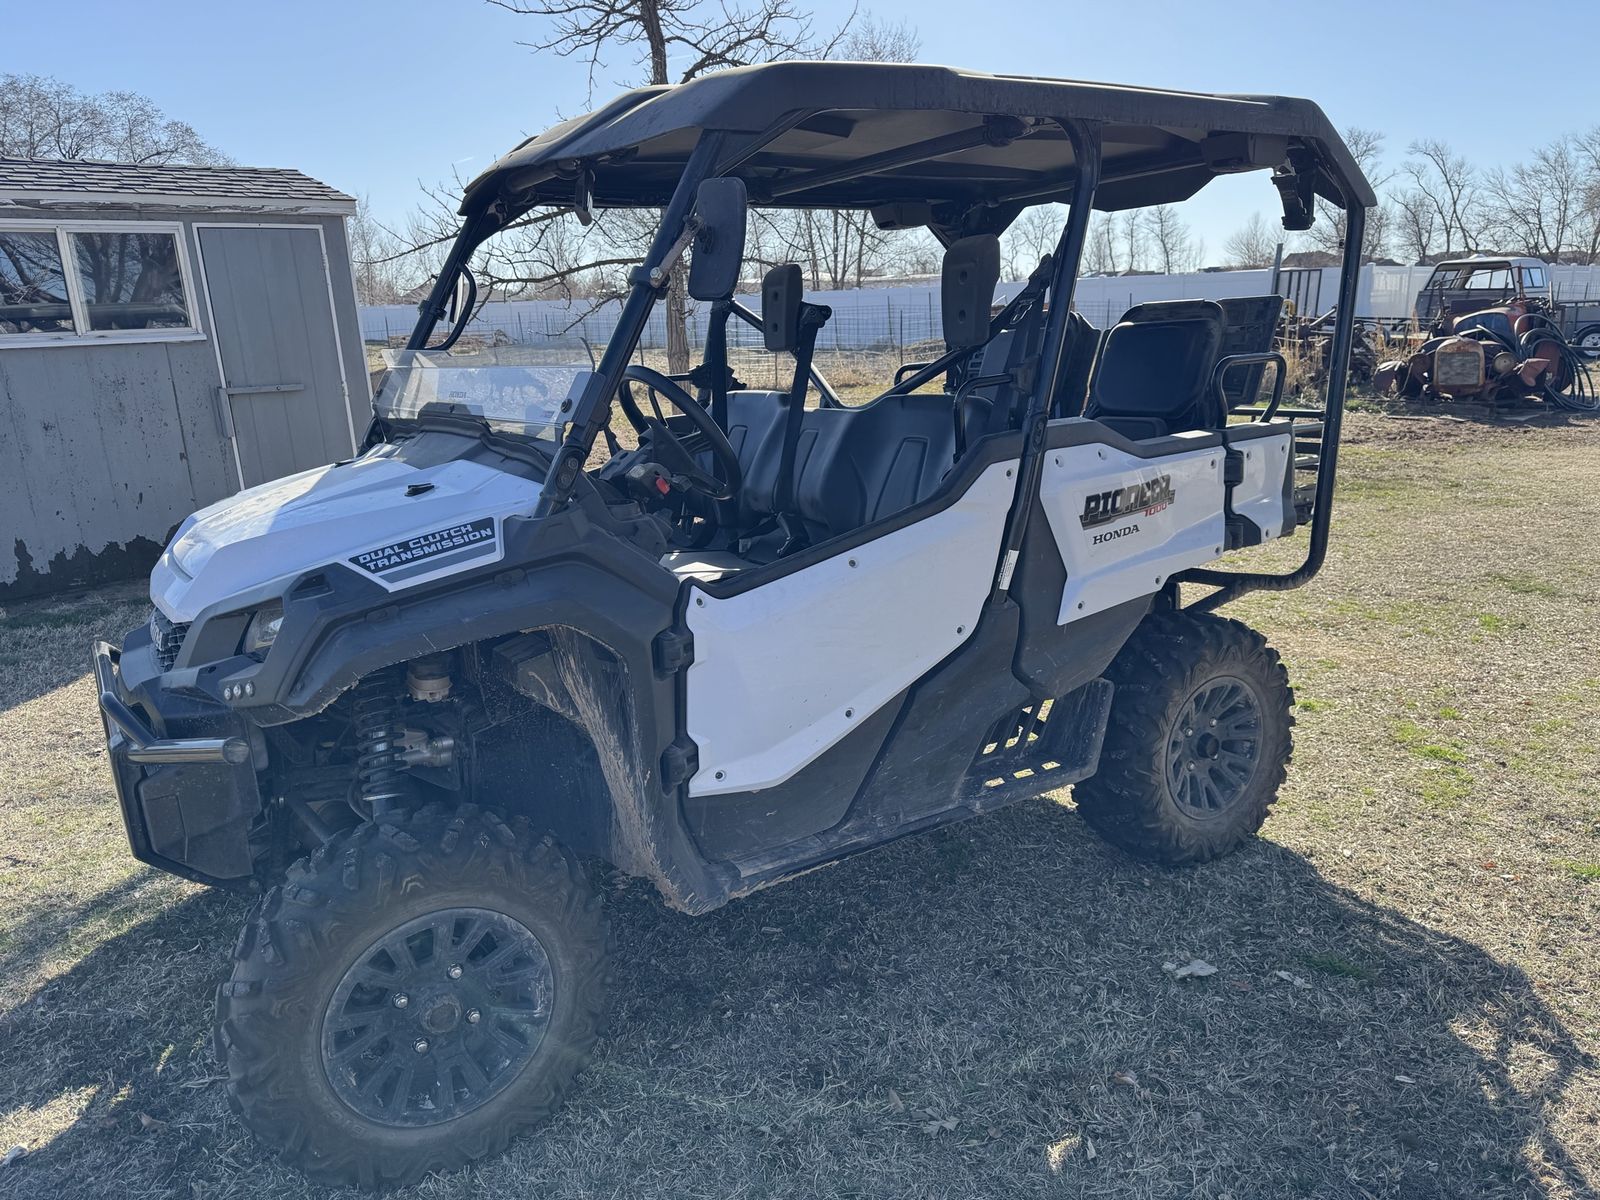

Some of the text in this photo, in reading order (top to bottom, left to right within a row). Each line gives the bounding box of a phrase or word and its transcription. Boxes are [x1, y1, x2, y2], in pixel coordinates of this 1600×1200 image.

[1080, 474, 1174, 524] PIONEER
[1143, 501, 1168, 517] 1000
[359, 524, 473, 564] DUAL CLUTCH
[366, 528, 492, 570] TRANSMISSION
[1092, 524, 1140, 545] HONDA
